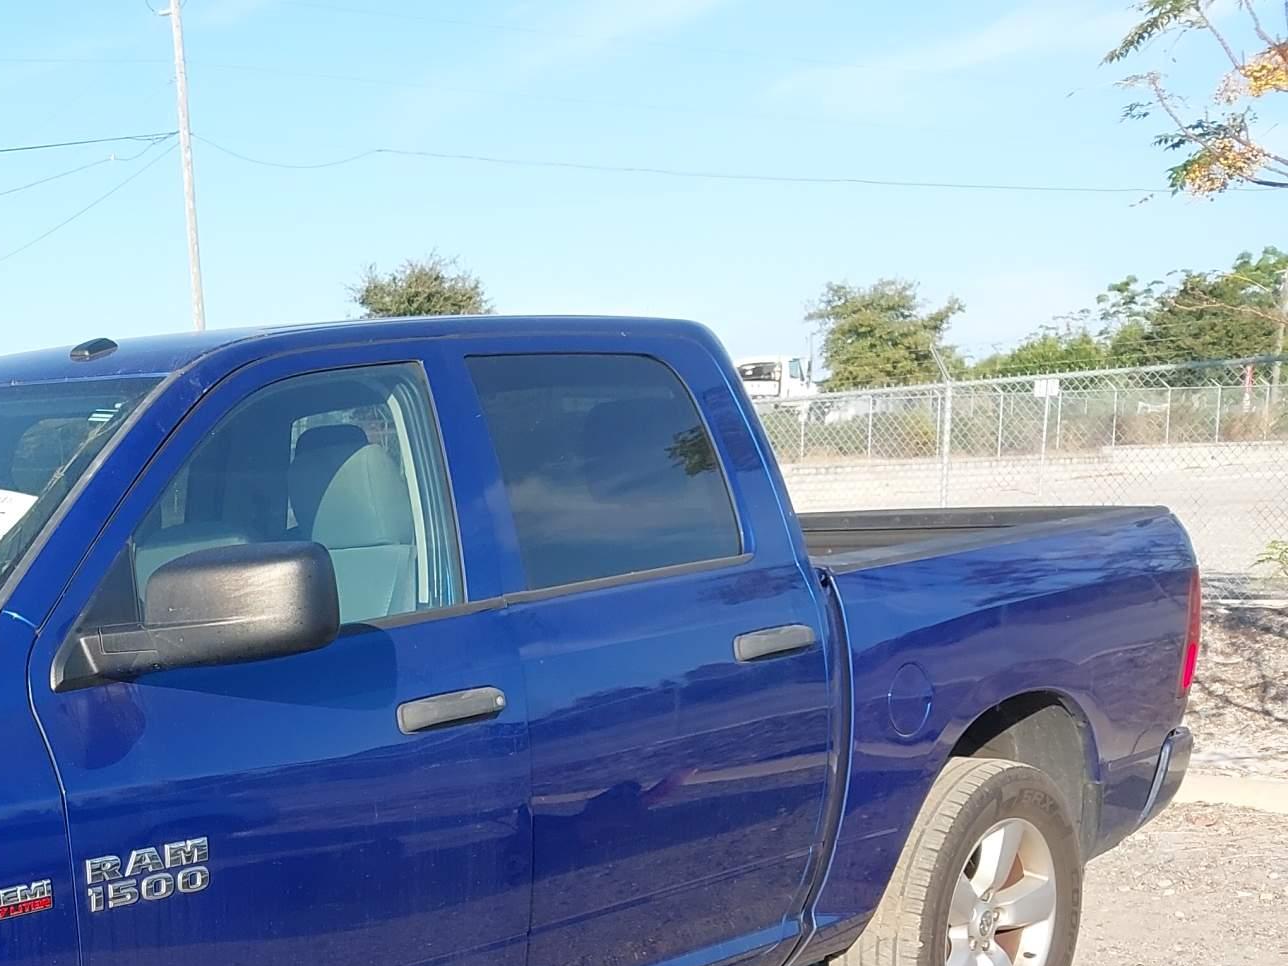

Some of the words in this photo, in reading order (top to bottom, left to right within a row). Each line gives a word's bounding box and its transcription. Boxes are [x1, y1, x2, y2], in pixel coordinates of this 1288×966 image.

[85, 837, 209, 885] RAM
[9, 897, 51, 916] LITER
[87, 865, 210, 912] 1500
